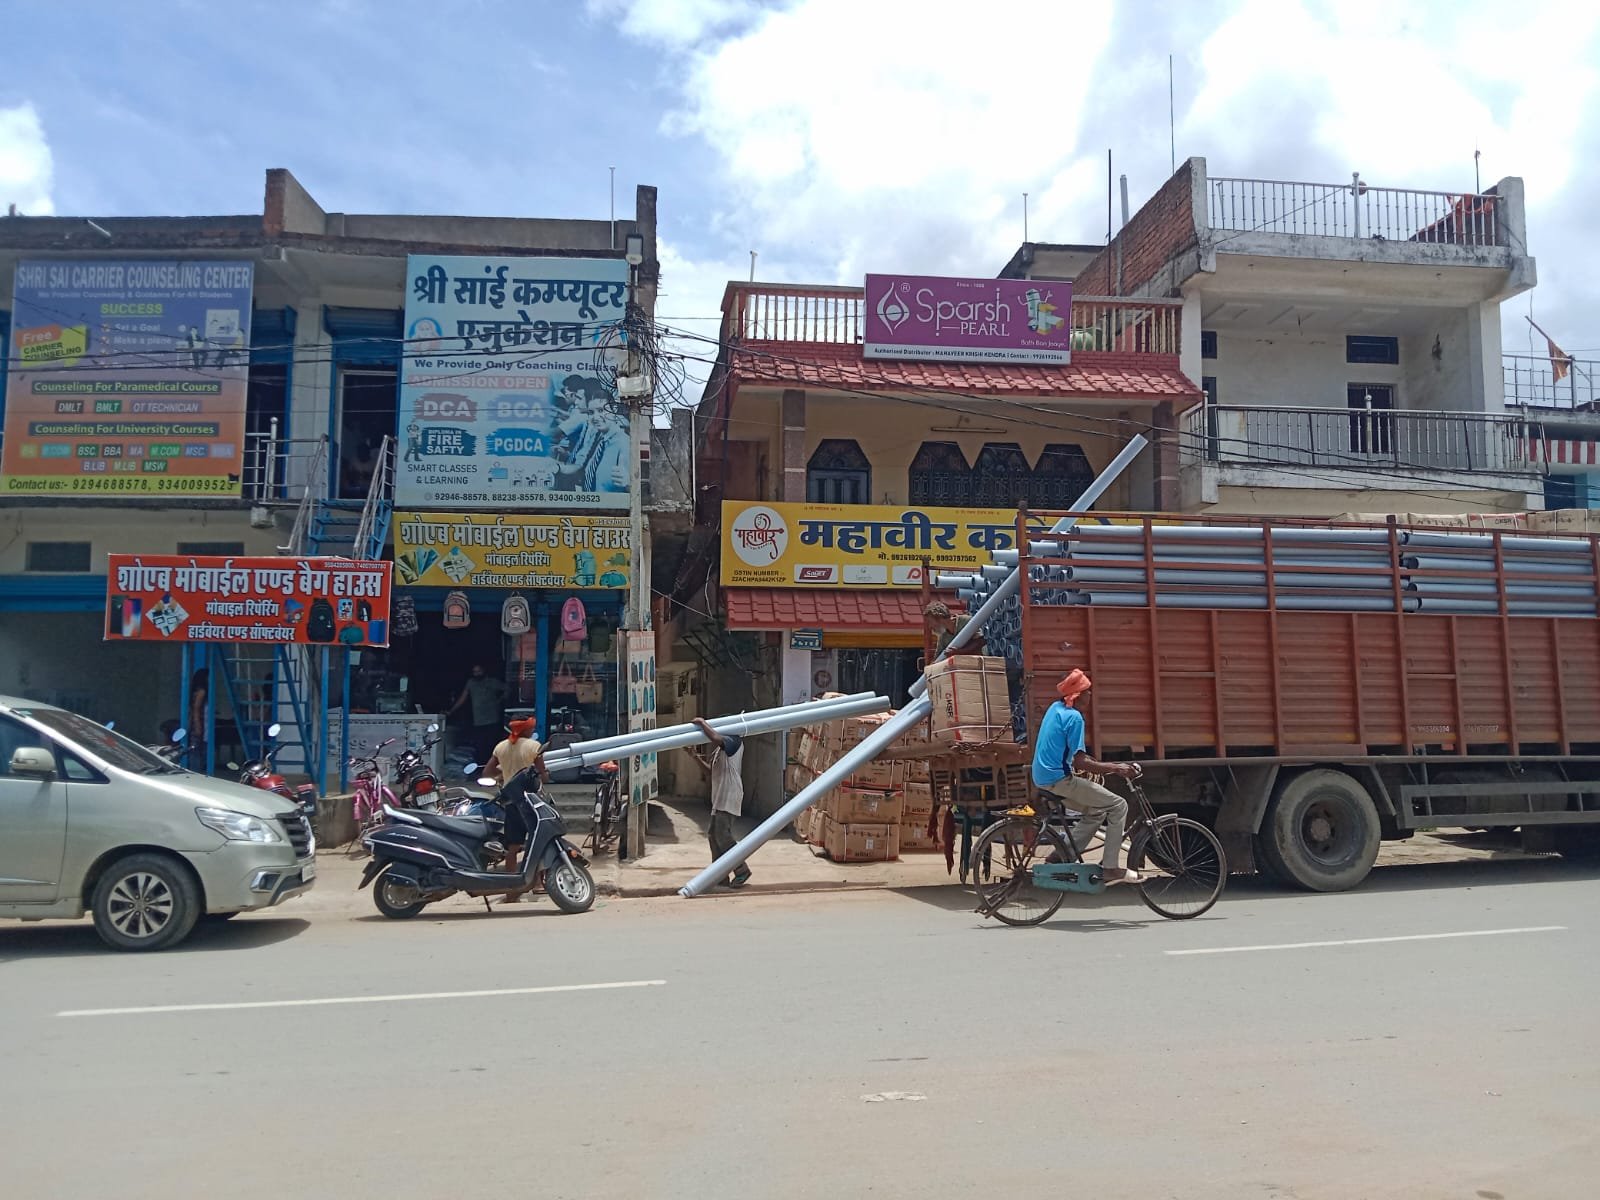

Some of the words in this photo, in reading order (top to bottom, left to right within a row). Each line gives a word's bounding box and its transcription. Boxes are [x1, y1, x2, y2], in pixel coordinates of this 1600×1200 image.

[19, 267, 47, 288] SHRI
[50, 267, 69, 288] SAI
[72, 267, 124, 288] CARRIER
[127, 267, 200, 288] COUNSELING
[204, 267, 250, 288] CENTER
[414, 265, 448, 304] श्री
[513, 279, 626, 320] कम्प्यूटर
[101, 303, 163, 314] SUCCESS
[916, 288, 1011, 337] Sparsh
[960, 322, 1010, 337] PEARL
[22, 330, 53, 343] Free
[23, 342, 63, 354] CARRIER
[23, 345, 83, 360] COUNSELING
[414, 360, 433, 368] We
[436, 360, 481, 369] Provide
[486, 360, 513, 372] Only
[516, 361, 573, 372] Coaching
[34, 382, 93, 393] Counseling
[95, 382, 113, 392] For
[115, 382, 180, 392] Paramedical
[181, 383, 219, 392] Course
[411, 375, 498, 388] ADMISSION
[504, 377, 547, 389] OPEN
[58, 402, 82, 412] DMLT
[96, 402, 119, 412] BMLT
[145, 402, 199, 412] TECHNICIAN
[423, 403, 471, 417] DCA
[498, 404, 545, 417] BCA
[35, 424, 94, 435] Counseling
[96, 424, 113, 434] For
[116, 424, 170, 437] University
[172, 424, 214, 434] Courses
[428, 435, 462, 446] FIRE
[494, 437, 544, 452] PGDCA
[103, 445, 122, 456] BBA
[427, 445, 465, 455] SAFTY
[144, 461, 167, 471] MSW
[407, 463, 437, 473] SMART
[439, 464, 478, 474] CLASSES
[9, 479, 47, 490] Contact
[415, 476, 422, 484] &
[424, 476, 469, 485] LEARNING
[401, 515, 449, 546] शोएब
[452, 516, 520, 551] मोबाईल
[522, 523, 560, 548] एण्ड
[561, 518, 591, 548] बैग
[734, 512, 785, 560] महावीर
[798, 511, 958, 555] महावीर
[118, 559, 172, 594] शोएब
[175, 559, 252, 598] मोबाईल
[254, 568, 297, 596] एण्ड
[297, 561, 331, 596] बैग
[333, 570, 384, 598] हाउस
[206, 598, 244, 618] मोबाइल
[188, 621, 226, 639] हार्डवेयर
[227, 625, 249, 640] एण्ड
[249, 622, 296, 641] सॉफ्टवेयर
